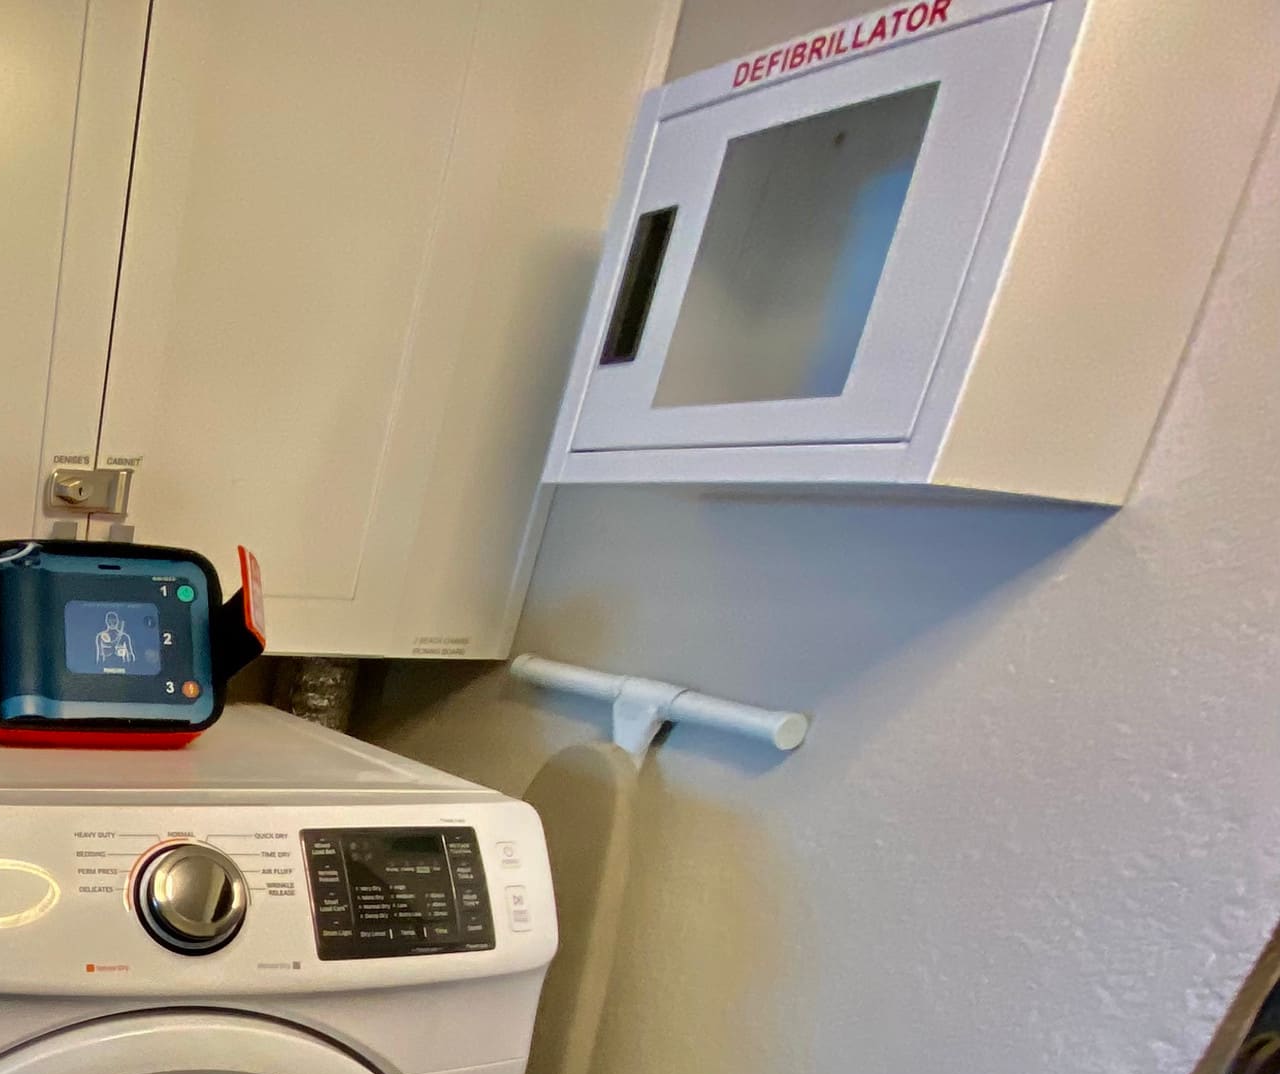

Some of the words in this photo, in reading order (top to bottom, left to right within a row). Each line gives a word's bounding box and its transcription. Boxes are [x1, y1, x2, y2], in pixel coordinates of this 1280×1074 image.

[732, 0, 951, 88] DEFIBRILLATOR
[160, 586, 168, 597] 1
[163, 633, 173, 645] 2
[166, 682, 175, 694] 3
[74, 831, 96, 839] HEAVY
[97, 831, 116, 839] DUTY
